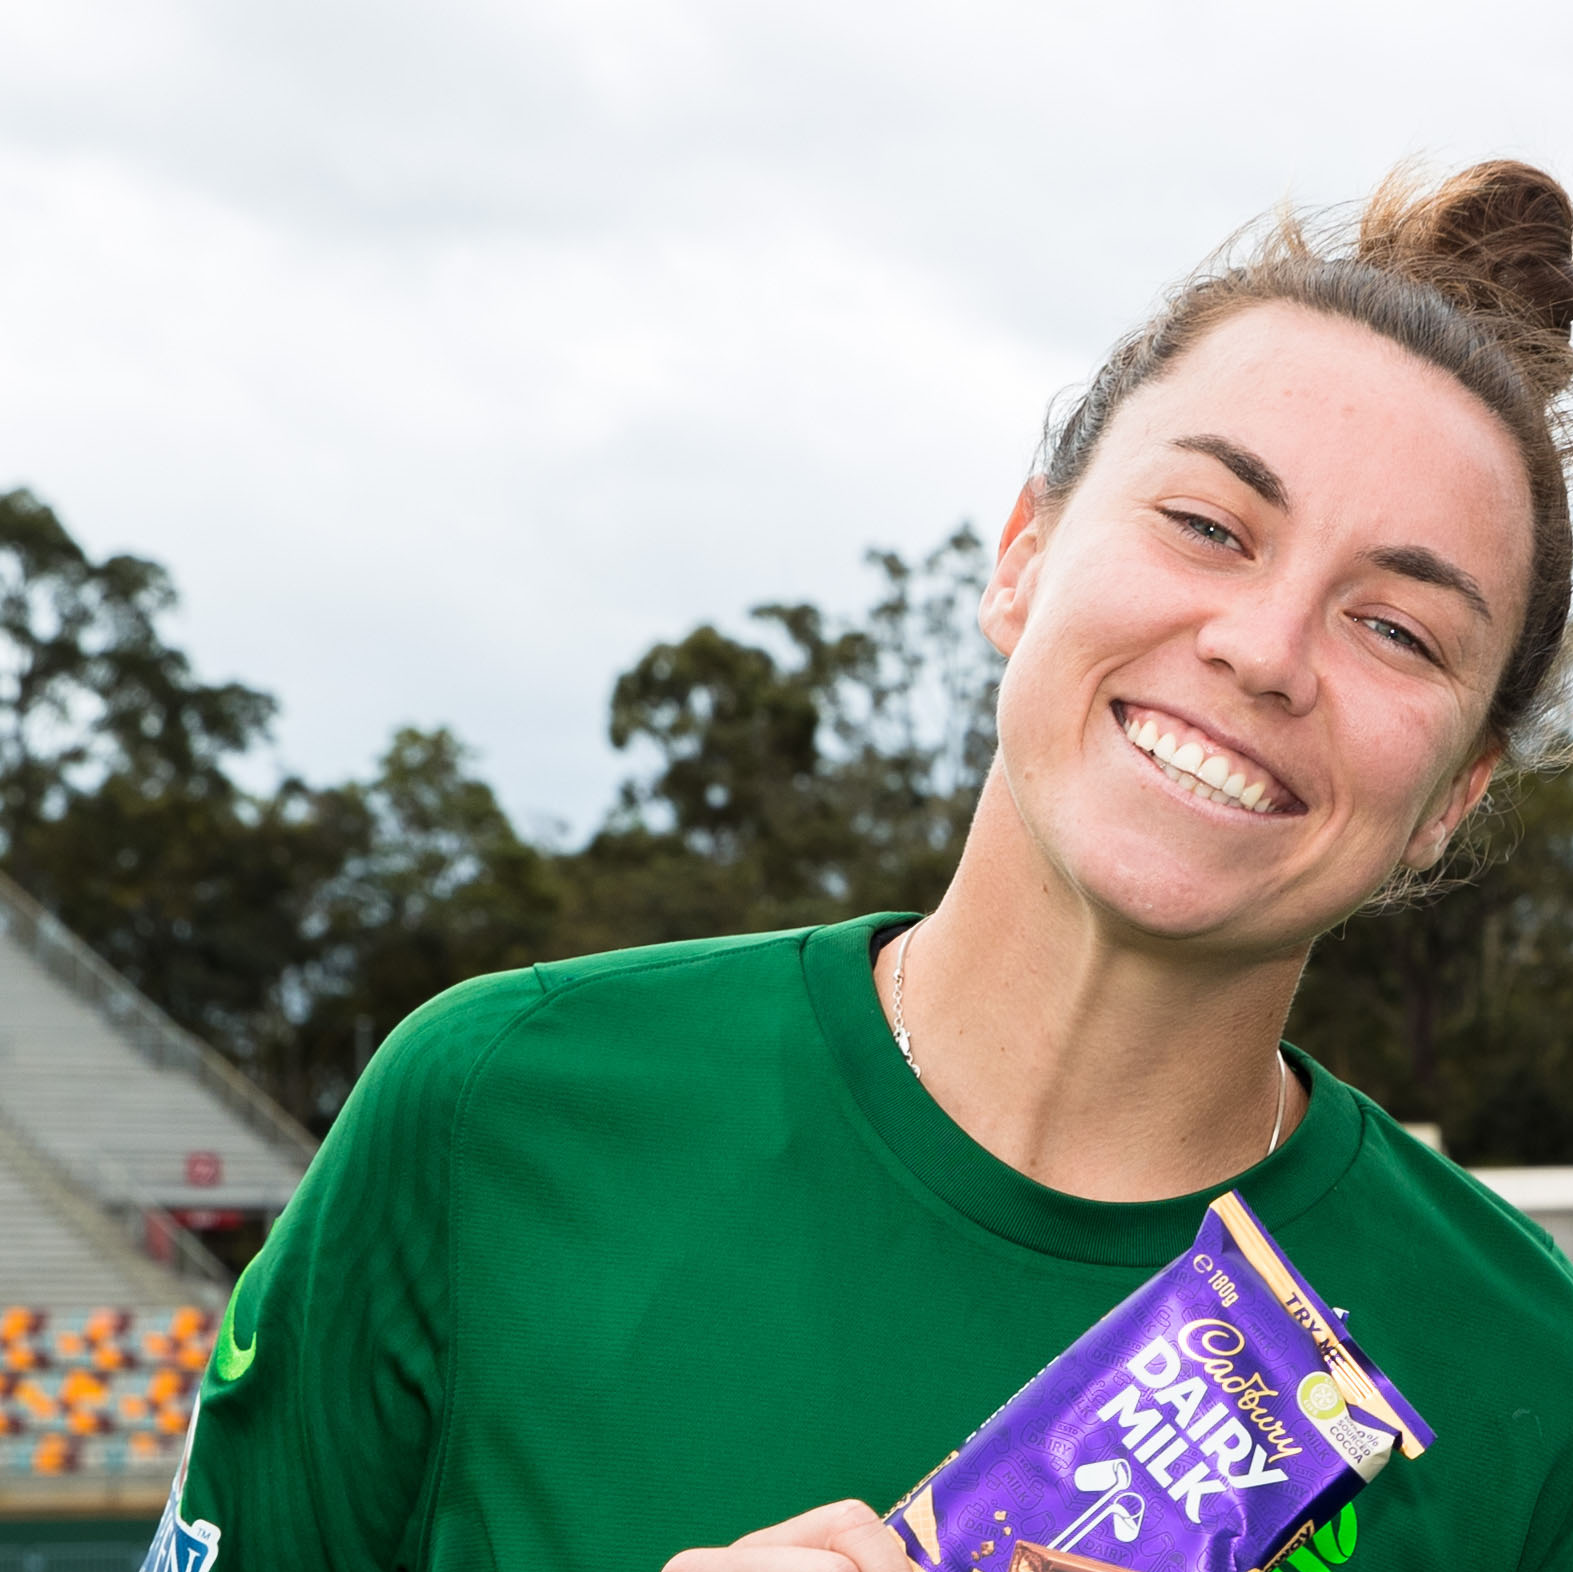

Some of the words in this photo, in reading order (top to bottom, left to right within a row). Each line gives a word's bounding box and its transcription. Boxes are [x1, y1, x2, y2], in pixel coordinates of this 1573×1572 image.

[1207, 1268, 1240, 1309] 180g
[1284, 1291, 1322, 1335] TRY
[1126, 1335, 1289, 1490] DAIRY
[1177, 1318, 1303, 1463] Cadbury
[1097, 1384, 1229, 1524] MILK
[1328, 1425, 1364, 1464] COCOA
[1335, 1418, 1372, 1457] SOURCED
